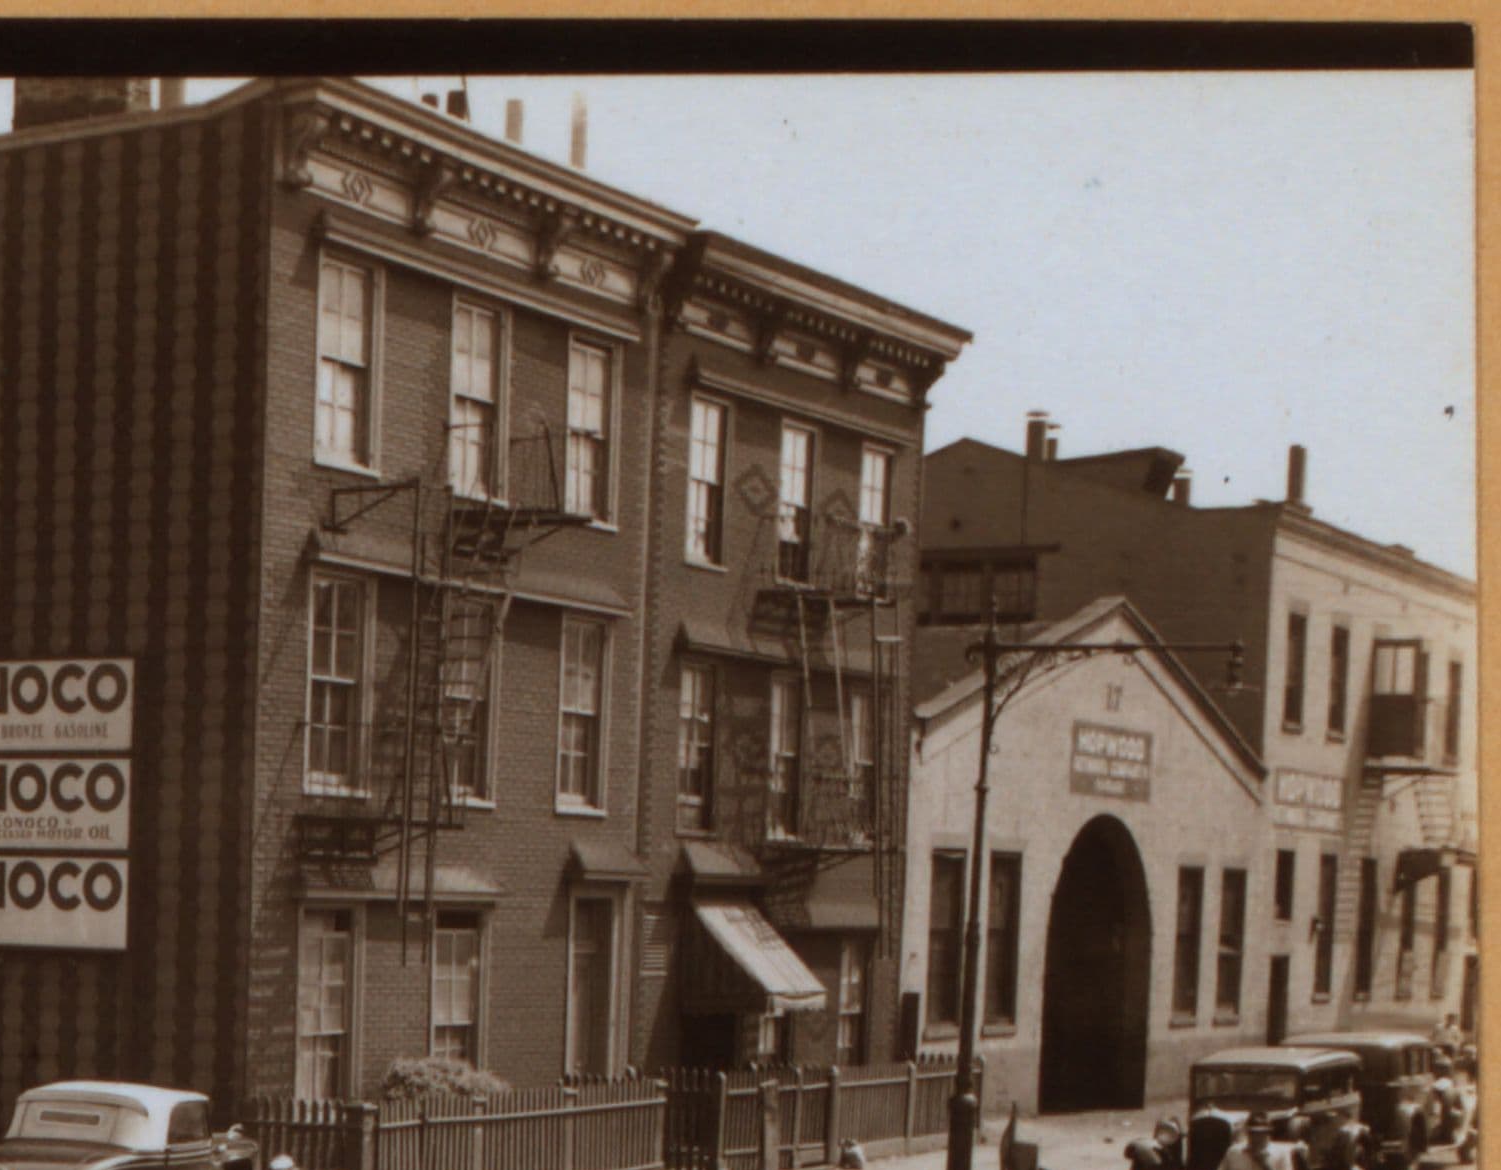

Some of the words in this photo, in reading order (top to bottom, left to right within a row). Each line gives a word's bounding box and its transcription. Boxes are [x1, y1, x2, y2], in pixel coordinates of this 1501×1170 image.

[2, 723, 44, 739] BRONZE
[54, 721, 108, 739] GASOLINE
[36, 827, 82, 839] MOTOR
[88, 825, 111, 840] OIL
